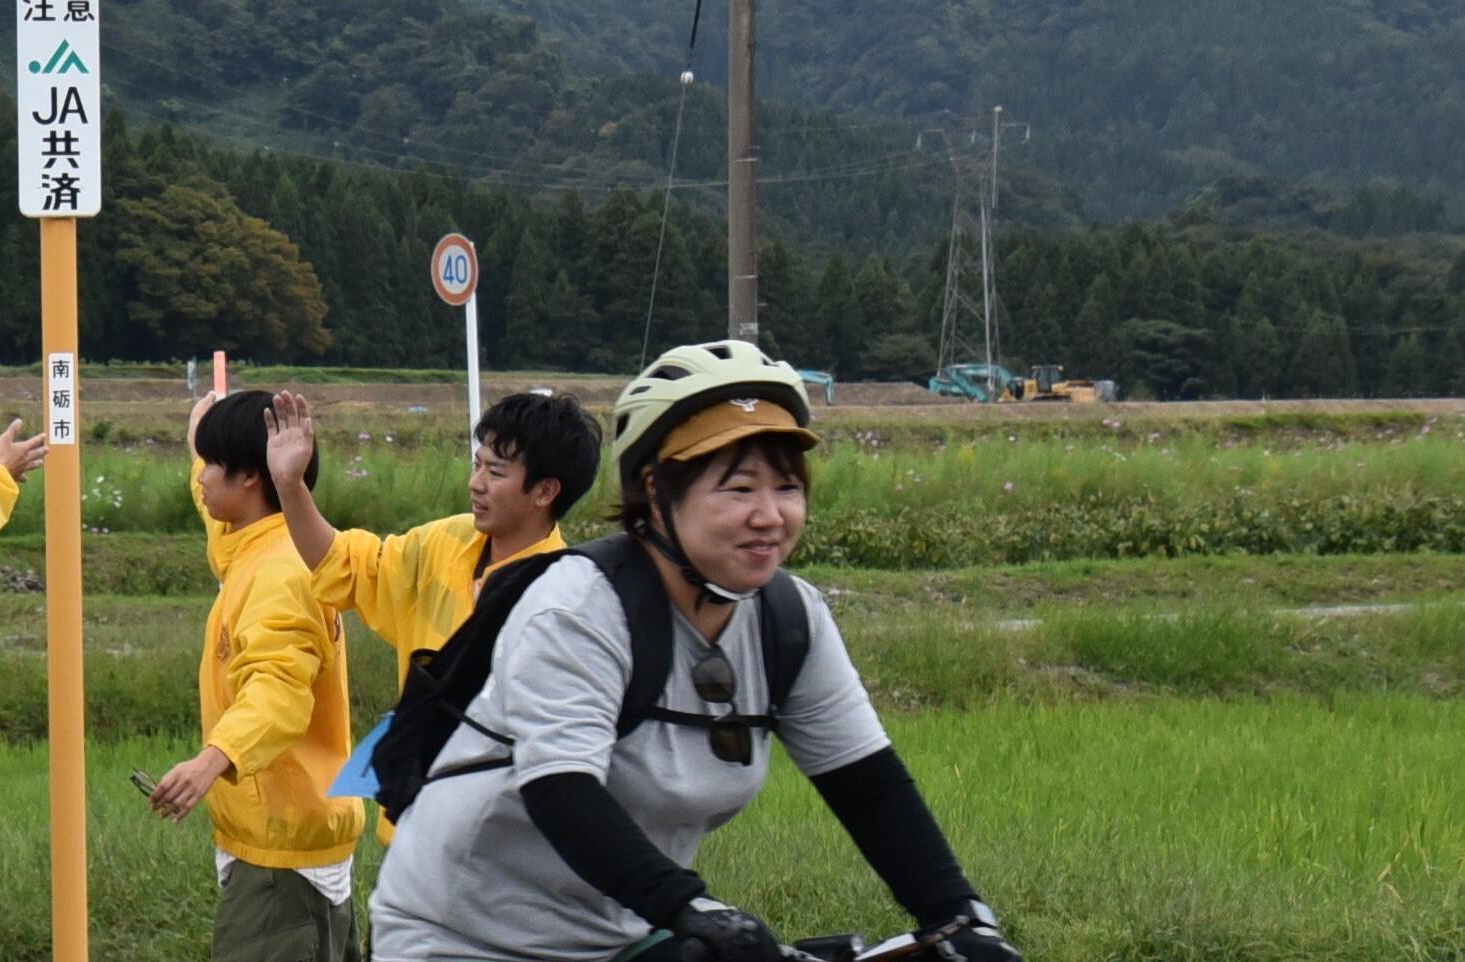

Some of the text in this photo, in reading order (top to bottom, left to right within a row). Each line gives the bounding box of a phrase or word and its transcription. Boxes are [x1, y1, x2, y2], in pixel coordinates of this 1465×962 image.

[442, 254, 468, 284] 40
[51, 359, 72, 440] 南砺市
